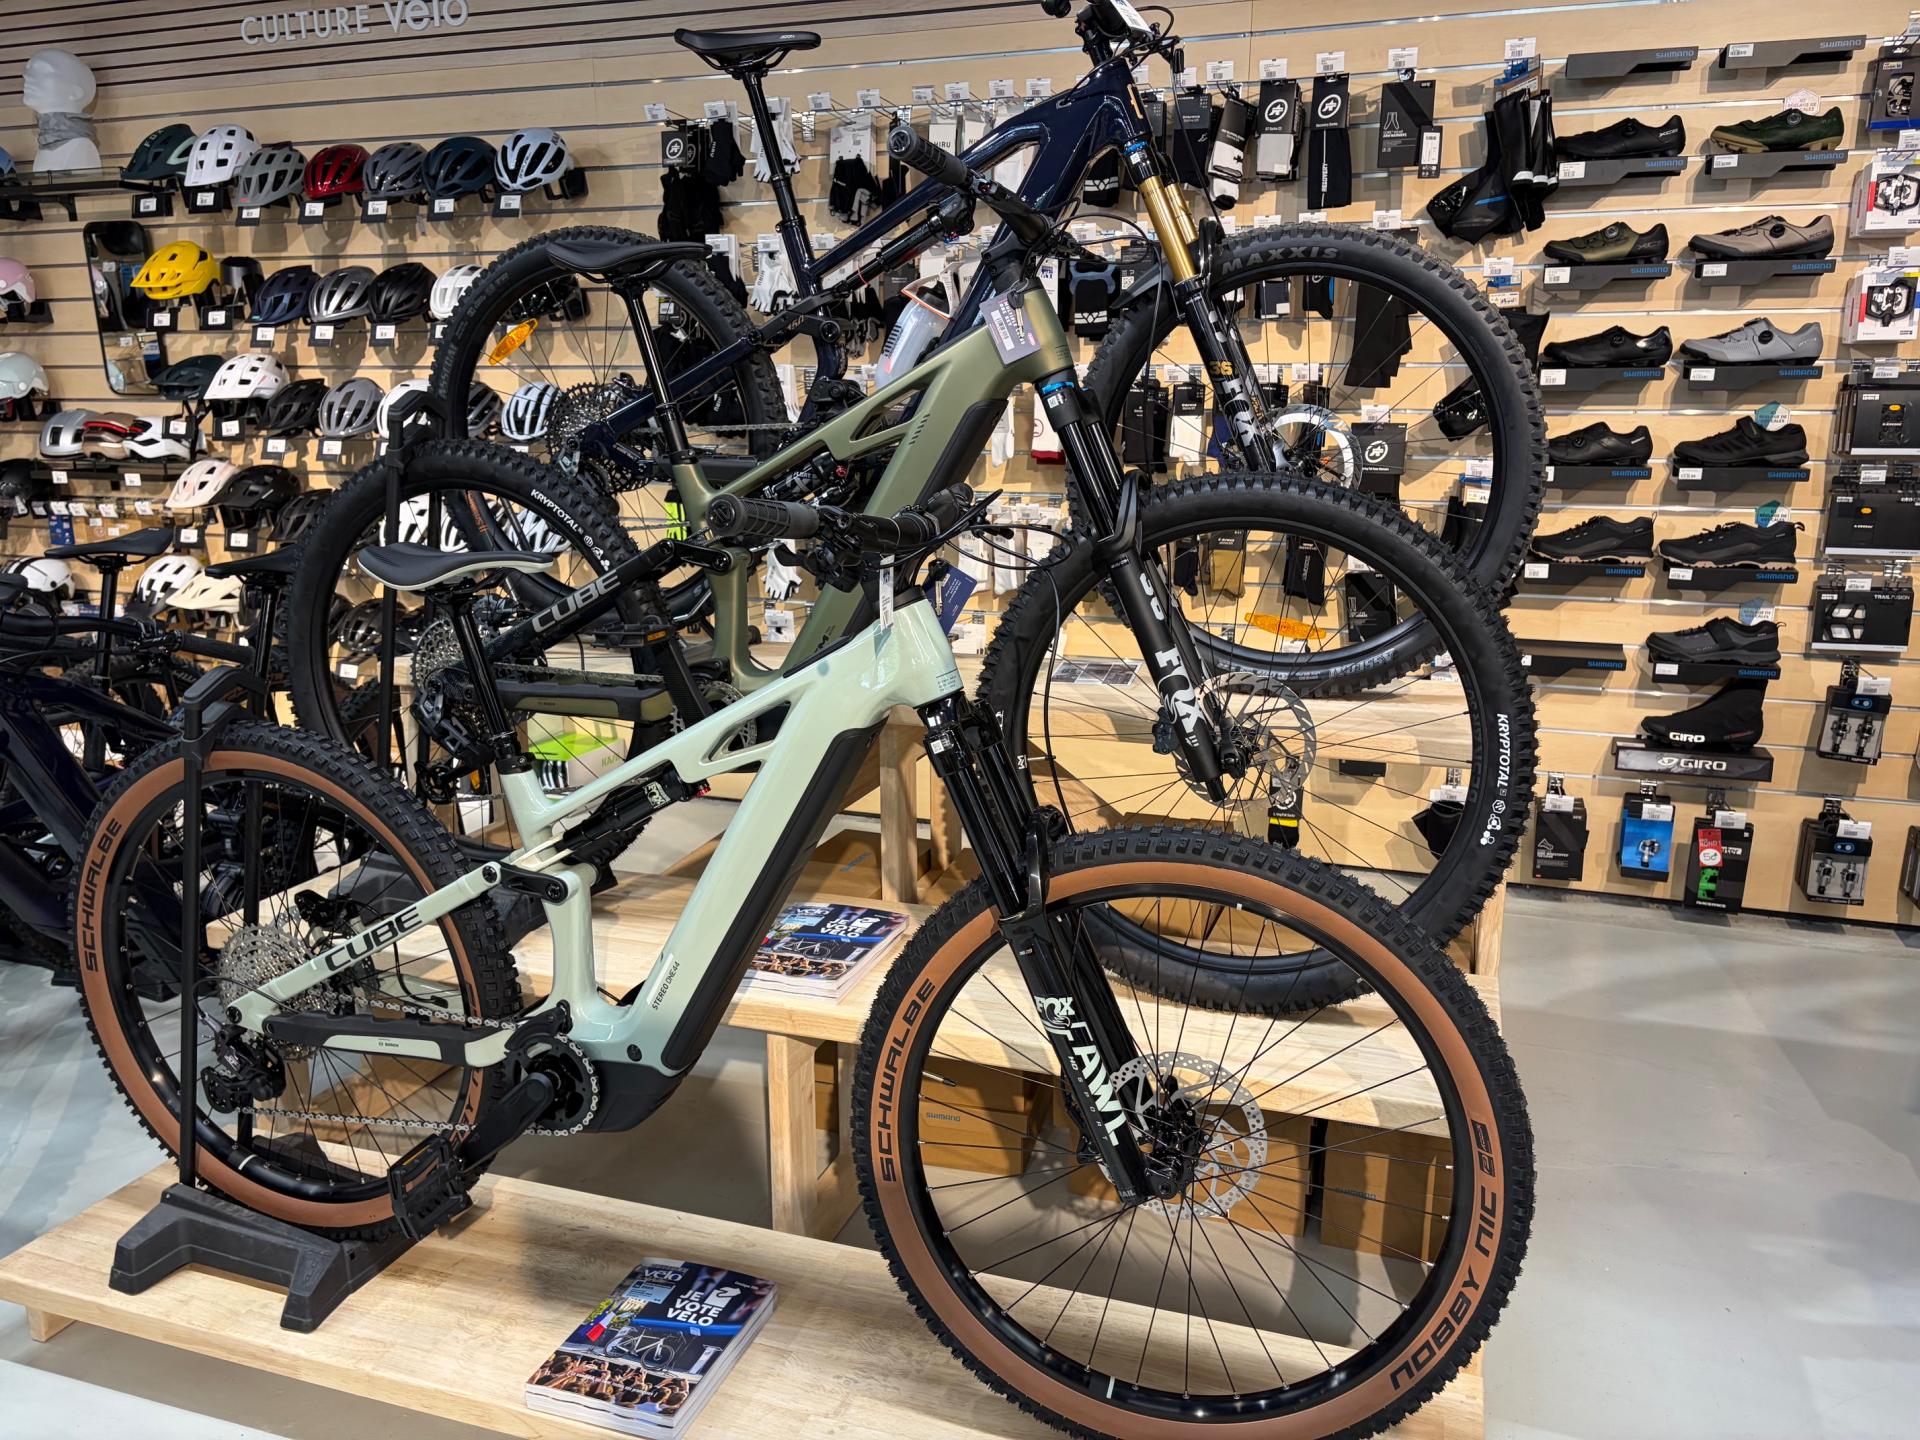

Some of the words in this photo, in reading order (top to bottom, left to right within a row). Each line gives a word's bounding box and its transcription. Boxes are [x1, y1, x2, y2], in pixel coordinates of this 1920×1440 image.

[240, 5, 370, 45] CULTURE
[1819, 39, 1862, 49] SHIMANO
[1655, 49, 1695, 59] SHIMANO
[1804, 152, 1845, 161] SHIMANO
[1645, 159, 1684, 168] SHIMANO
[1222, 246, 1339, 275] MAXXIS
[1791, 263, 1832, 271] SHIMANO
[1630, 266, 1669, 274] SHIMANO
[1623, 370, 1661, 378] SHIMANO
[1778, 368, 1819, 376] SHIMANO
[530, 488, 580, 533] KRYPTOTAL
[1605, 568, 1642, 576] SHIMANO
[1756, 572, 1795, 581] SHIMANO
[531, 569, 621, 633] CUBE
[1587, 660, 1624, 669] SHIMANO
[1738, 668, 1777, 677] SHIMANO
[1669, 732, 1706, 743] GIRO
[1496, 713, 1511, 788] KRYPTOTAL
[1679, 758, 1727, 771] GIRO
[82, 818, 122, 973] SCHWALBE
[826, 922, 866, 935] VOTE
[324, 906, 423, 972] CUBE
[651, 983, 669, 1011] STEREO
[666, 961, 681, 985] ONE44
[1033, 996, 1076, 1017] FOX
[877, 977, 936, 1183] SCHWALBE
[926, 1111, 961, 1122] SHIMANO
[1390, 1263, 1480, 1390] NOBBY
[1474, 1185, 1497, 1257] NIC
[679, 1289, 704, 1302] JE
[674, 1299, 723, 1318] VOTE
